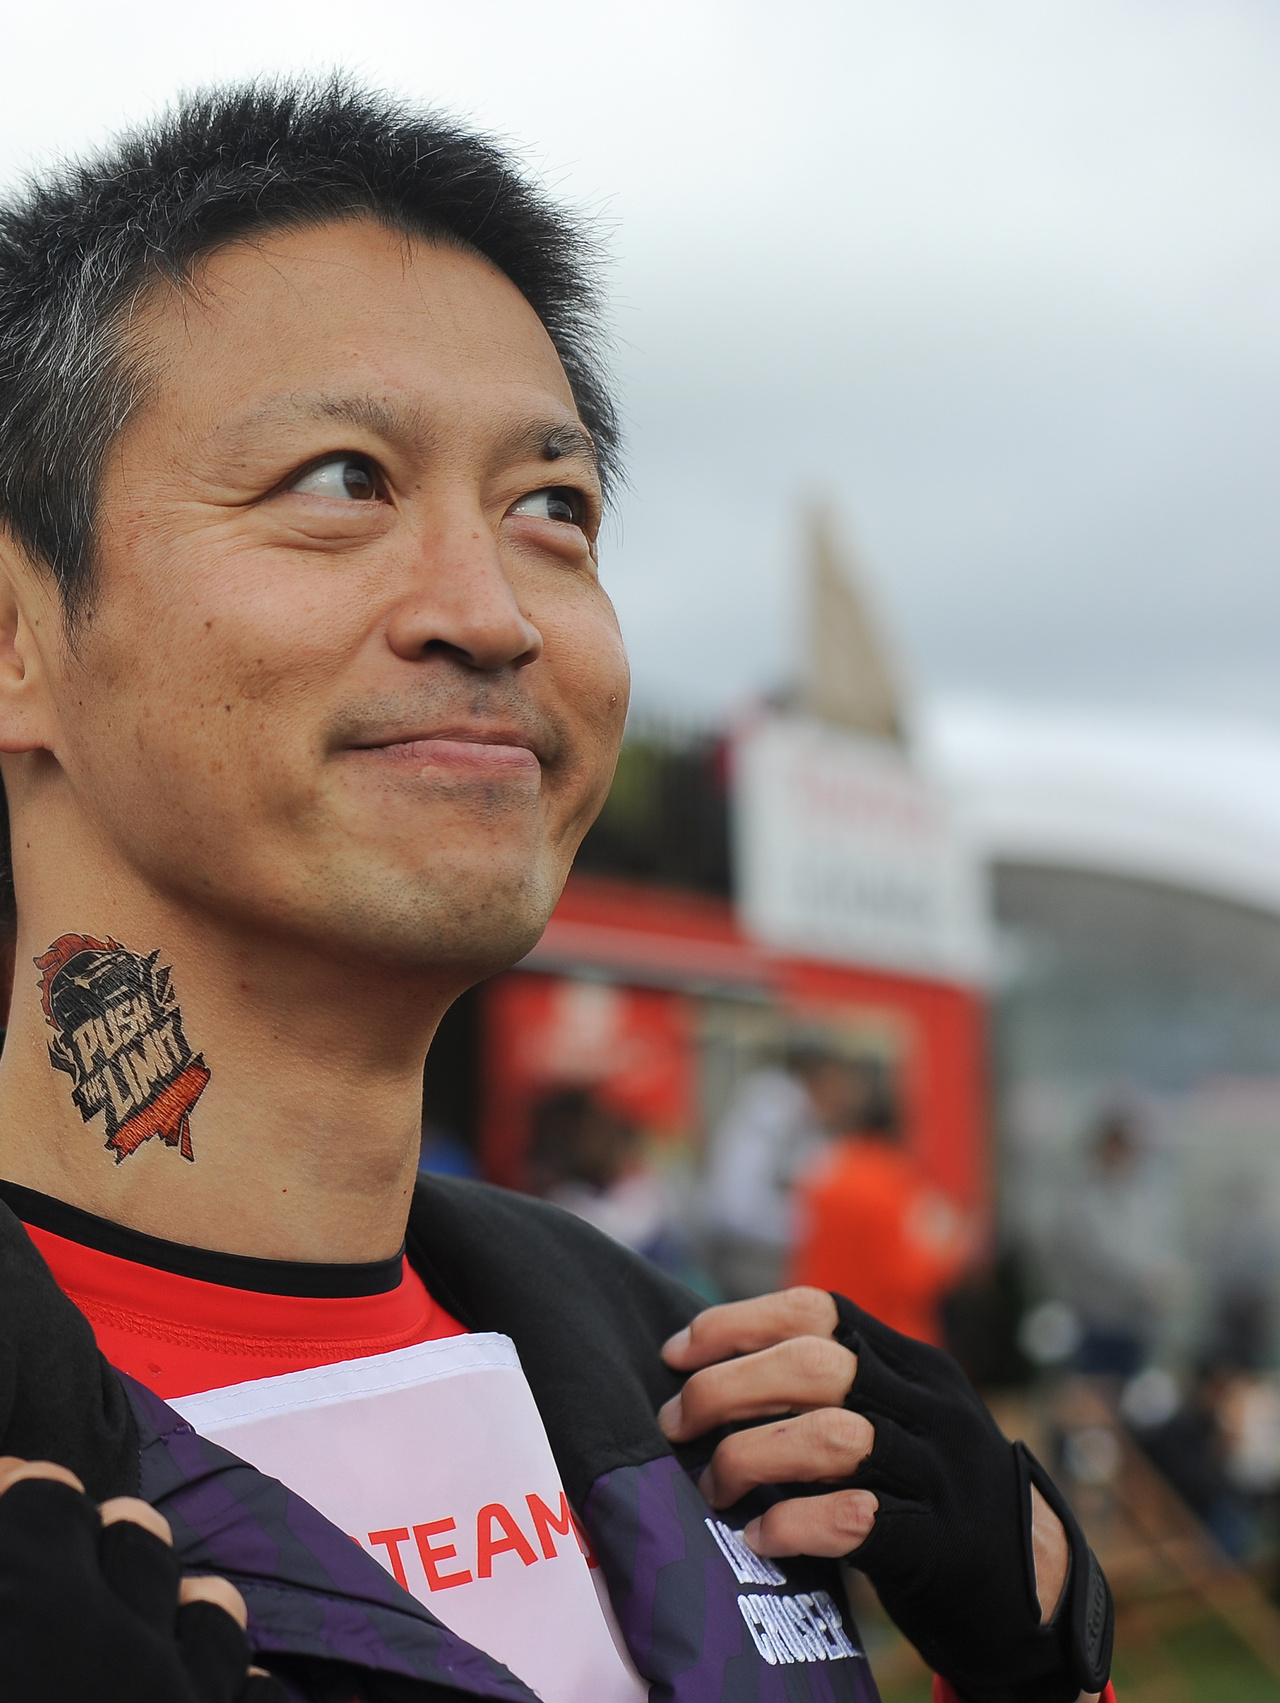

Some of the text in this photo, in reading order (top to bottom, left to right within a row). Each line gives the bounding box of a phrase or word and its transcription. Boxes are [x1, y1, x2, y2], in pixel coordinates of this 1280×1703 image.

[72, 991, 153, 1072] PUSH
[80, 1021, 183, 1123] THE LIMIT
[349, 1491, 599, 1593] TEAM
